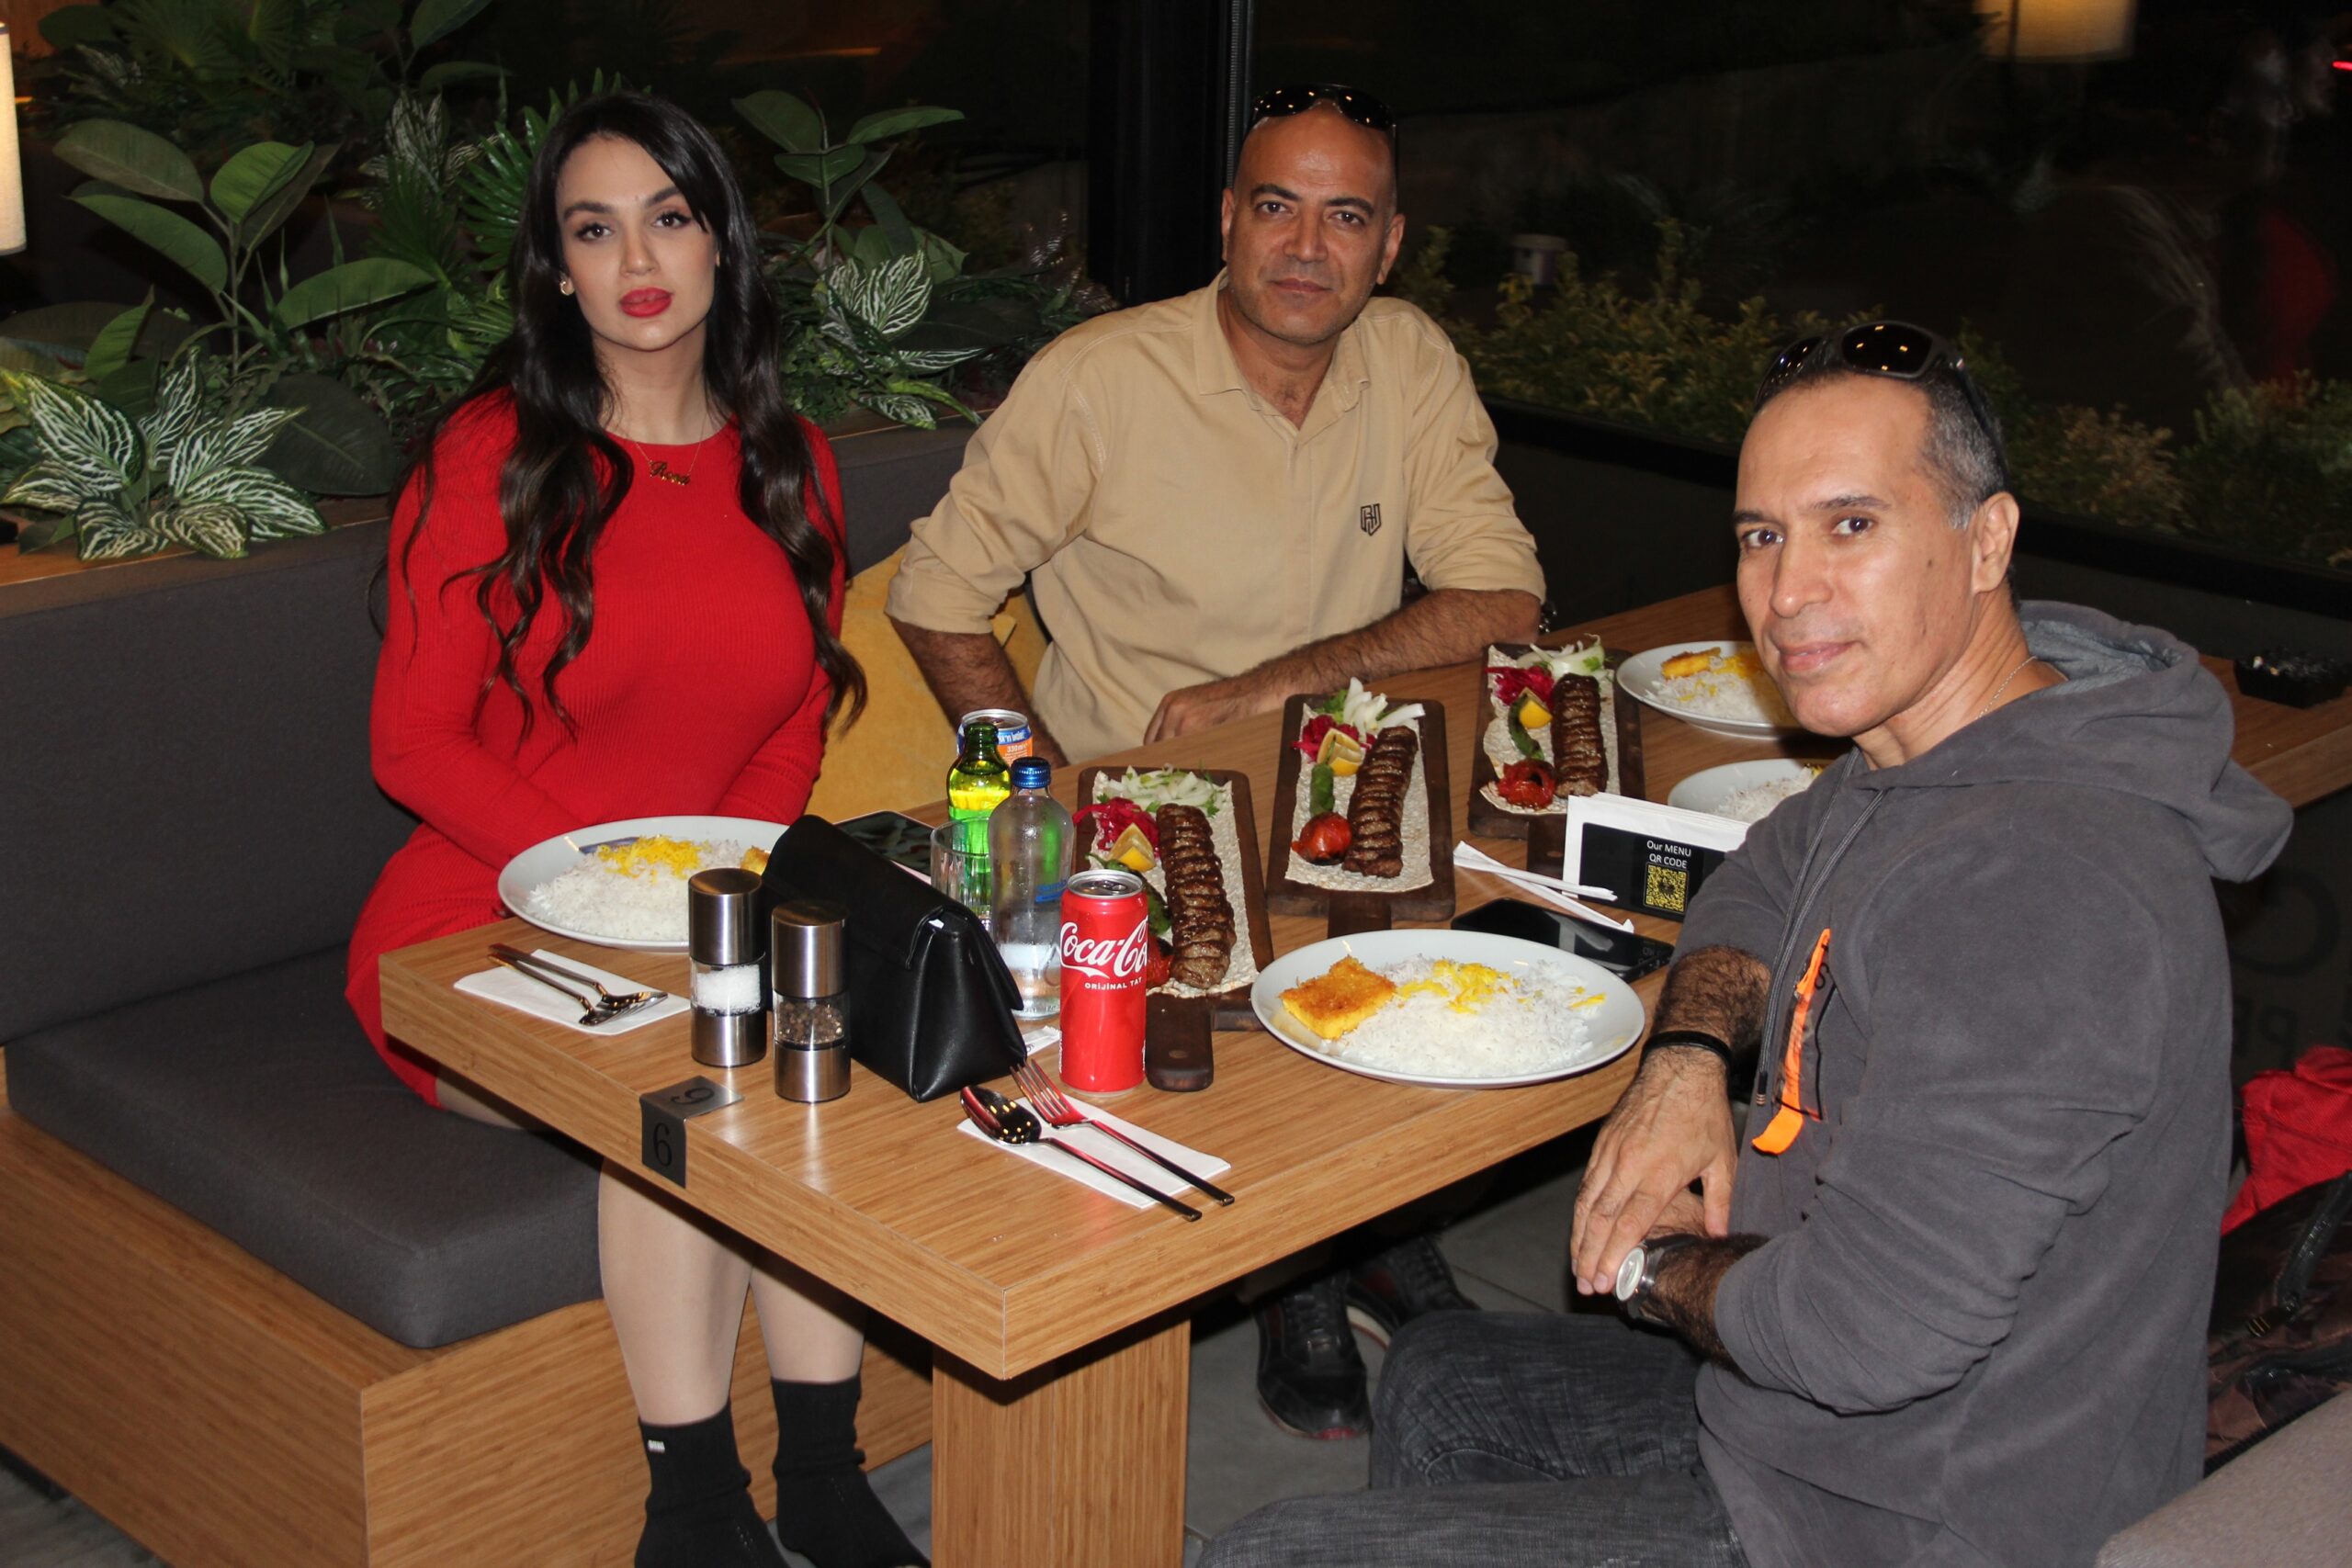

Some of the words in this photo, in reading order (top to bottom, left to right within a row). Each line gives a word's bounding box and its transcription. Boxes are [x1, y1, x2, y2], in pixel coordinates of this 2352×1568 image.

[1646, 840, 1663, 851] Our
[1664, 843, 1691, 857] MENU
[1649, 853, 1662, 863] QR
[1663, 856, 1688, 869] CODE
[1060, 915, 1148, 980] Coca-Co
[652, 1122, 673, 1168] 6
